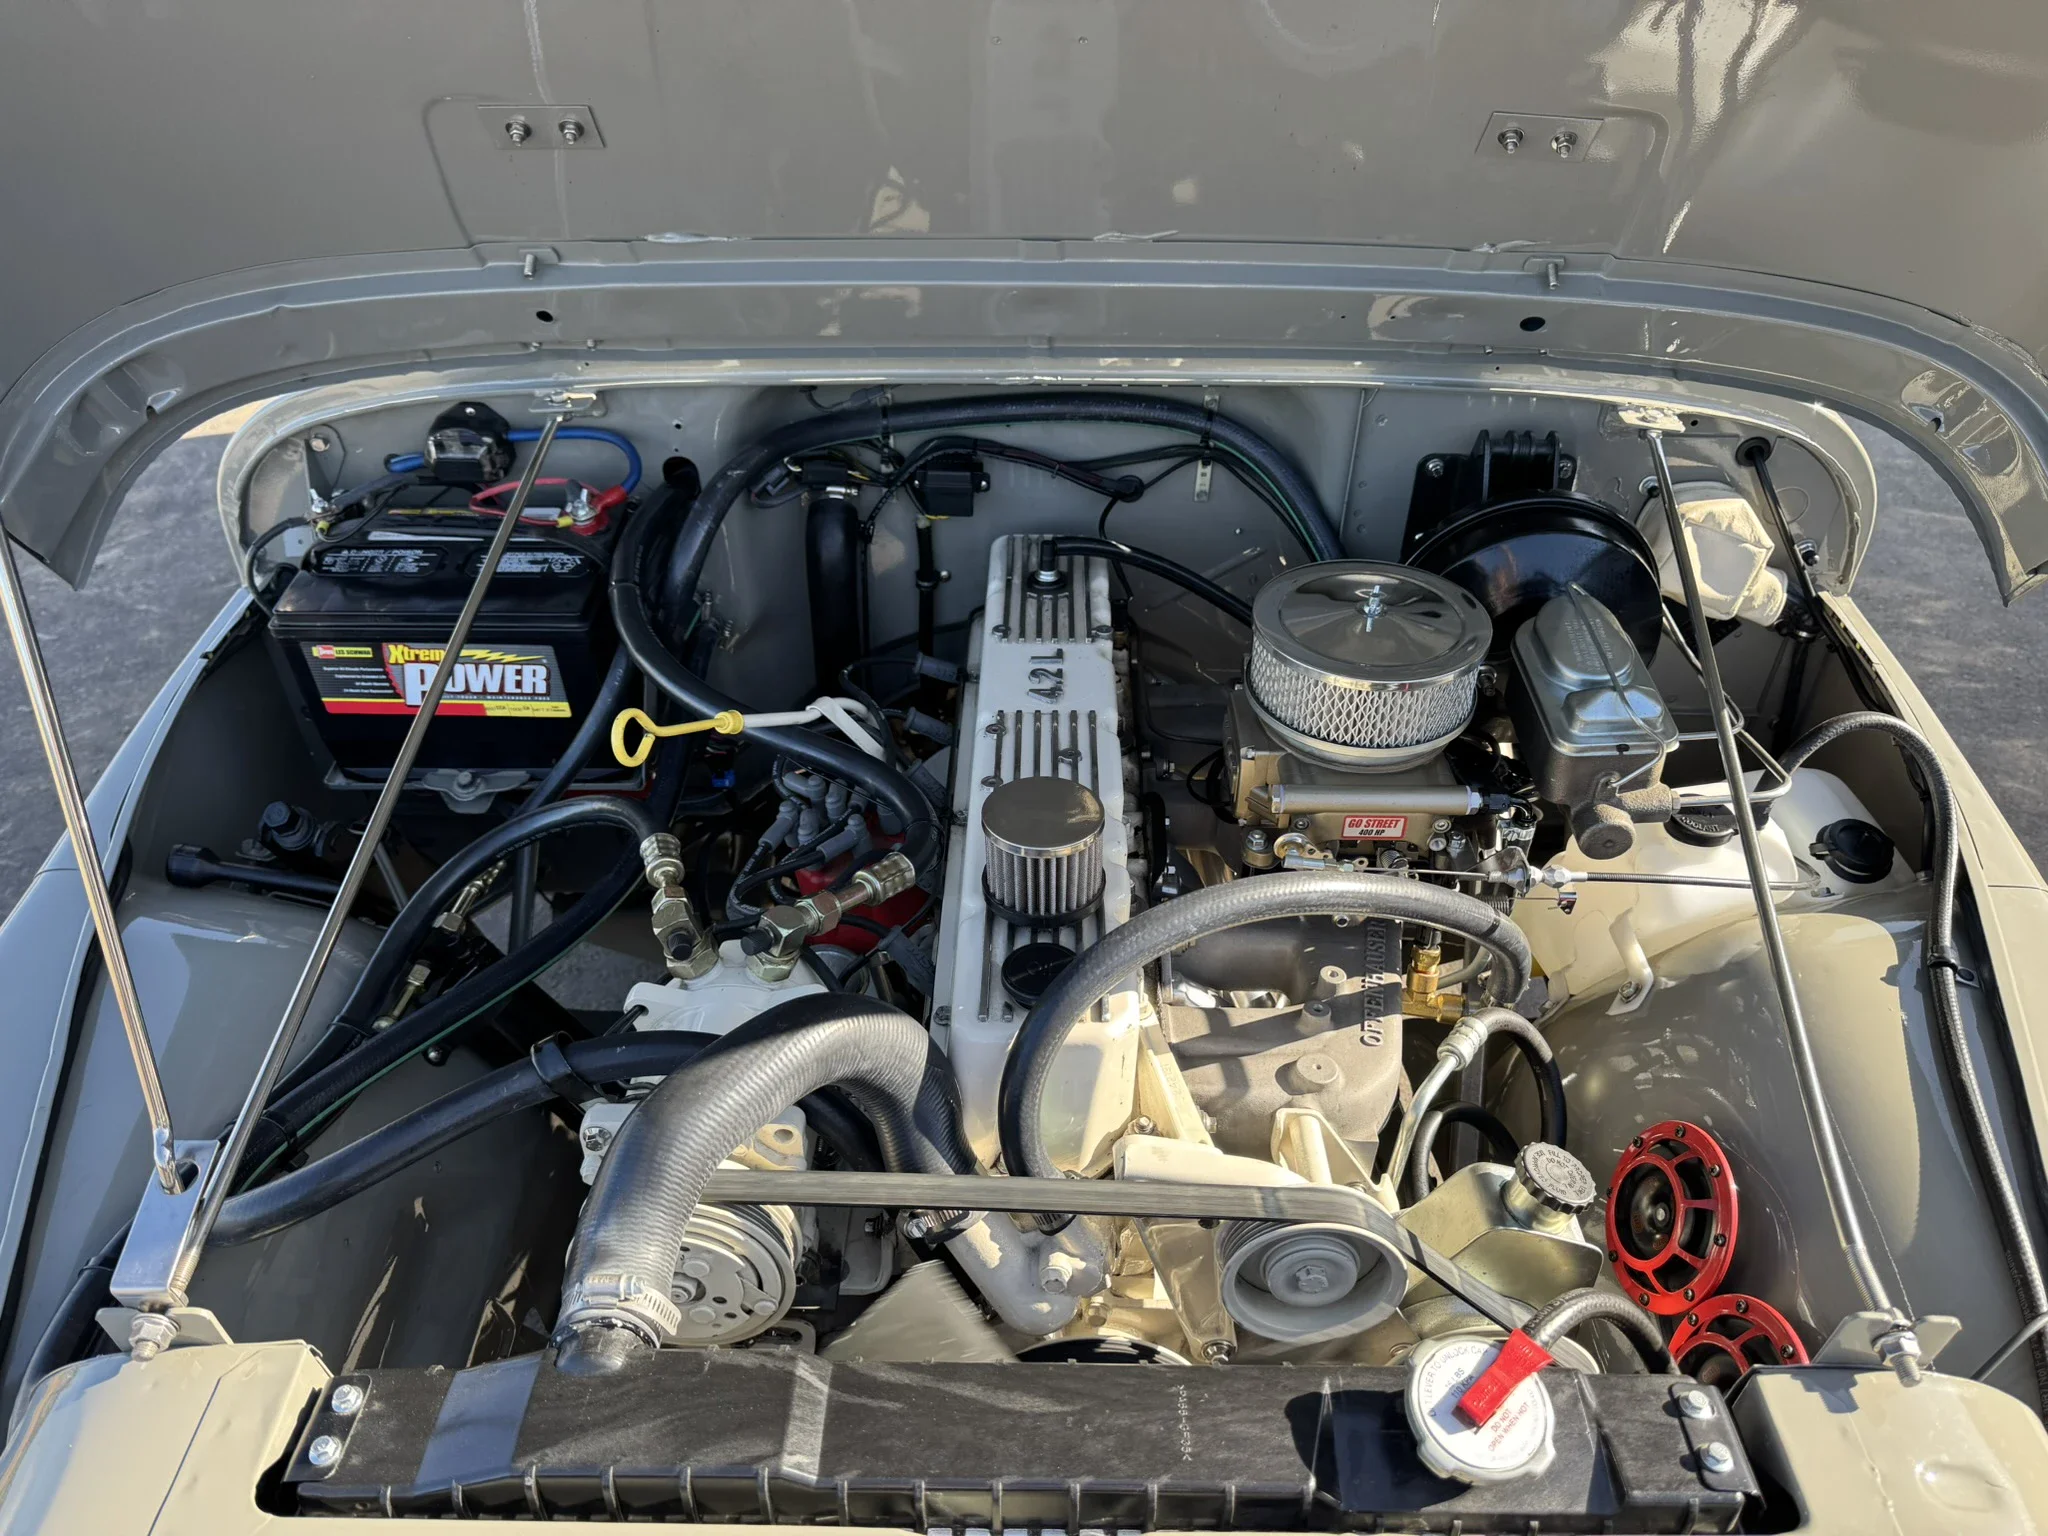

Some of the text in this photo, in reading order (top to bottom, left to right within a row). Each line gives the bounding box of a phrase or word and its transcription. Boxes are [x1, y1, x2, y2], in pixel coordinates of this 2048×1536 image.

[389, 644, 446, 664] Xtrem
[1348, 819, 1401, 828] GO STREET
[1547, 1149, 1561, 1159] FILL
[1562, 1155, 1571, 1164] TO
[1488, 1434, 1505, 1452] OPEN
[1502, 1415, 1519, 1434] WHEN
[1518, 1401, 1530, 1417] HOT
[1491, 1408, 1513, 1433] DO NOT
